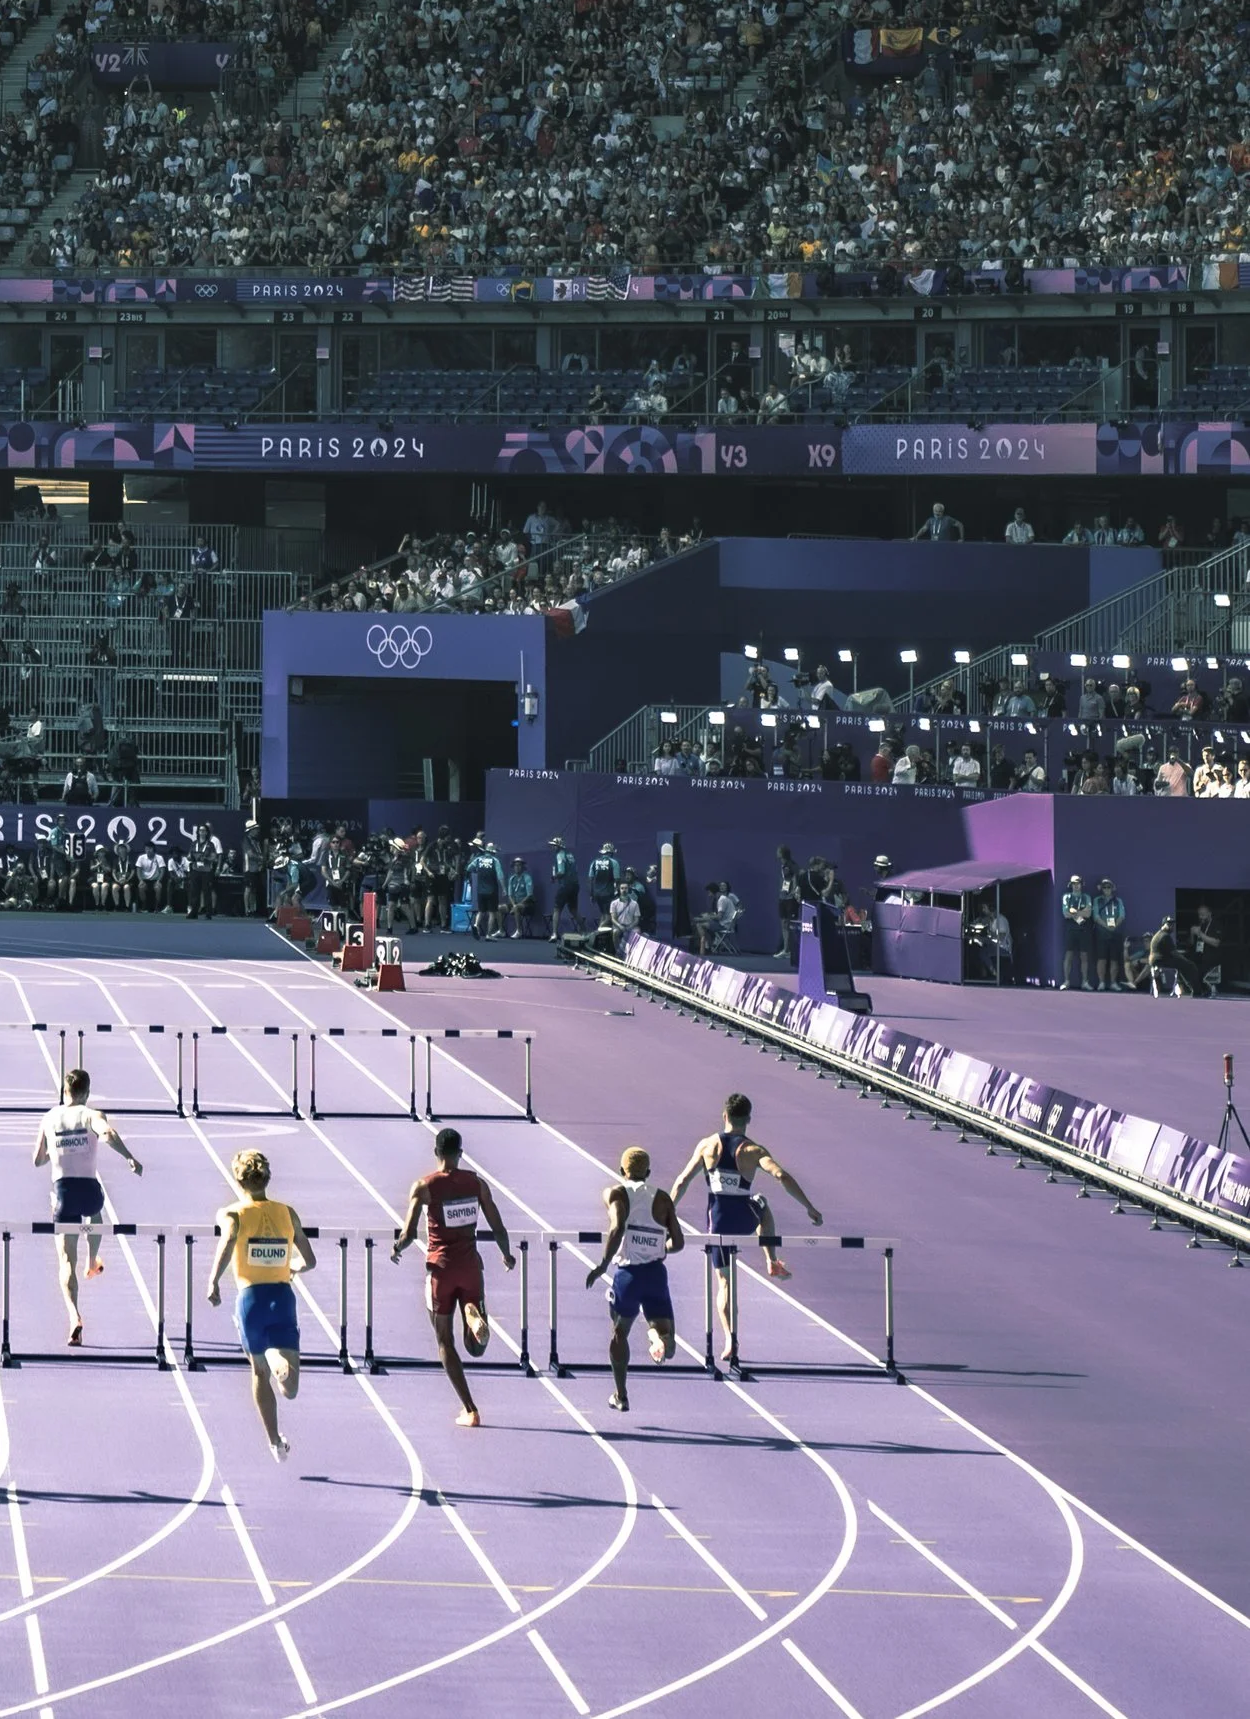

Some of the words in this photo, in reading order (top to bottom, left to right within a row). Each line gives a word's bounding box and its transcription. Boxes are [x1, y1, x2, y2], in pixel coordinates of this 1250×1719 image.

[95, 53, 120, 73] Y2
[253, 284, 299, 297] PARIS
[304, 284, 343, 296] 2024
[922, 308, 934, 318] 20
[1124, 303, 1134, 313] 19
[1177, 303, 1187, 313] 18
[55, 311, 67, 321] 24
[282, 312, 295, 322] 23
[342, 312, 354, 322] 22
[713, 310, 725, 320] 21
[262, 437, 340, 459] PARIS
[353, 437, 424, 459] 2024
[896, 437, 968, 461] PARIS
[979, 437, 1045, 460] 2024
[721, 444, 747, 468] Y3
[808, 444, 835, 467] X9
[509, 769, 534, 779] PARIS
[536, 770, 559, 780] 2024
[617, 776, 643, 785] PARIS
[645, 776, 669, 786] 2024
[691, 778, 717, 788] PARIS
[720, 780, 745, 789] 2024
[767, 781, 794, 792] PARIS
[796, 782, 822, 793] 2024
[844, 785, 872, 795] PARIS
[875, 786, 898, 796] 2024
[55, 1137, 88, 1148] WARHOLM
[446, 1206, 477, 1220] SAMBA
[631, 1234, 658, 1248] NUNEZ
[251, 1248, 286, 1258] EDLUND
